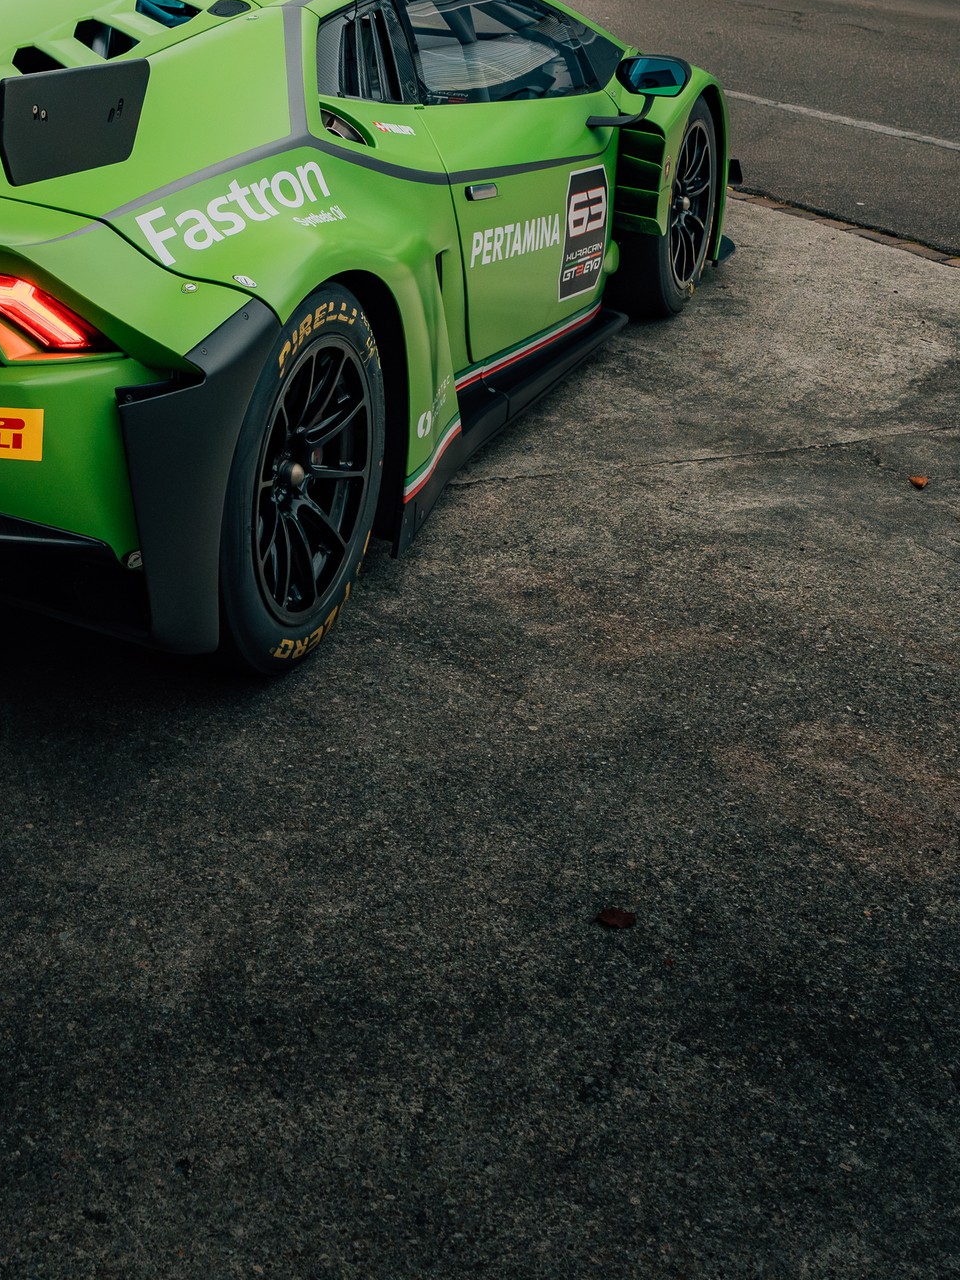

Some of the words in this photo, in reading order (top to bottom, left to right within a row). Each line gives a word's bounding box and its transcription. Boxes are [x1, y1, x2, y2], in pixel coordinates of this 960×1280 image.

[135, 161, 331, 266] Fastron
[568, 186, 607, 238] 63
[470, 213, 560, 269] PERTAMINA
[566, 242, 603, 262] HURACAN
[278, 301, 359, 379] PIRELLI
